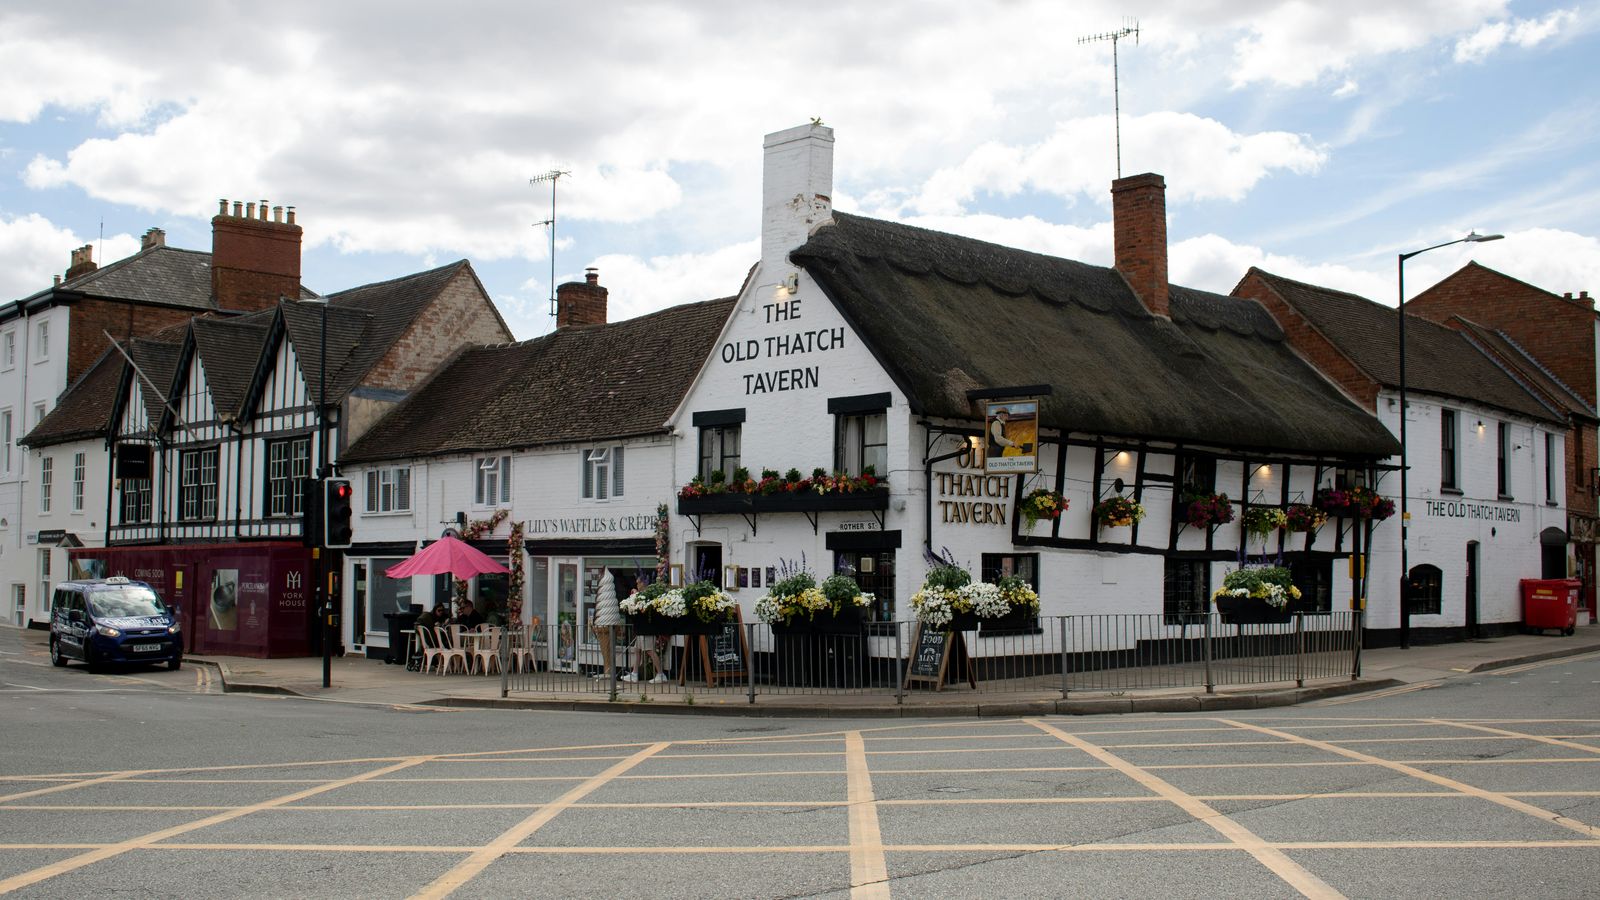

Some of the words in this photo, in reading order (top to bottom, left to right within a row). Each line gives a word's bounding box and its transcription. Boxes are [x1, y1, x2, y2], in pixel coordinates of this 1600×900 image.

[763, 300, 801, 323] THE
[722, 340, 759, 363] OLD
[764, 327, 844, 357] THATCH
[743, 366, 819, 395] TAVERN
[956, 448, 985, 469] OL
[935, 472, 1009, 498] THATCH
[938, 501, 1006, 525] TAVERN
[1426, 501, 1446, 516] THE
[1447, 502, 1466, 518] OLD
[1467, 504, 1493, 520] THATCH
[1494, 506, 1520, 522] TAVERN
[528, 519, 558, 533] LILY'S
[560, 518, 606, 533] WAFFLES
[609, 518, 616, 532] &
[135, 569, 152, 577] COMING
[152, 569, 164, 578] SOON
[922, 635, 943, 644] FOOD
